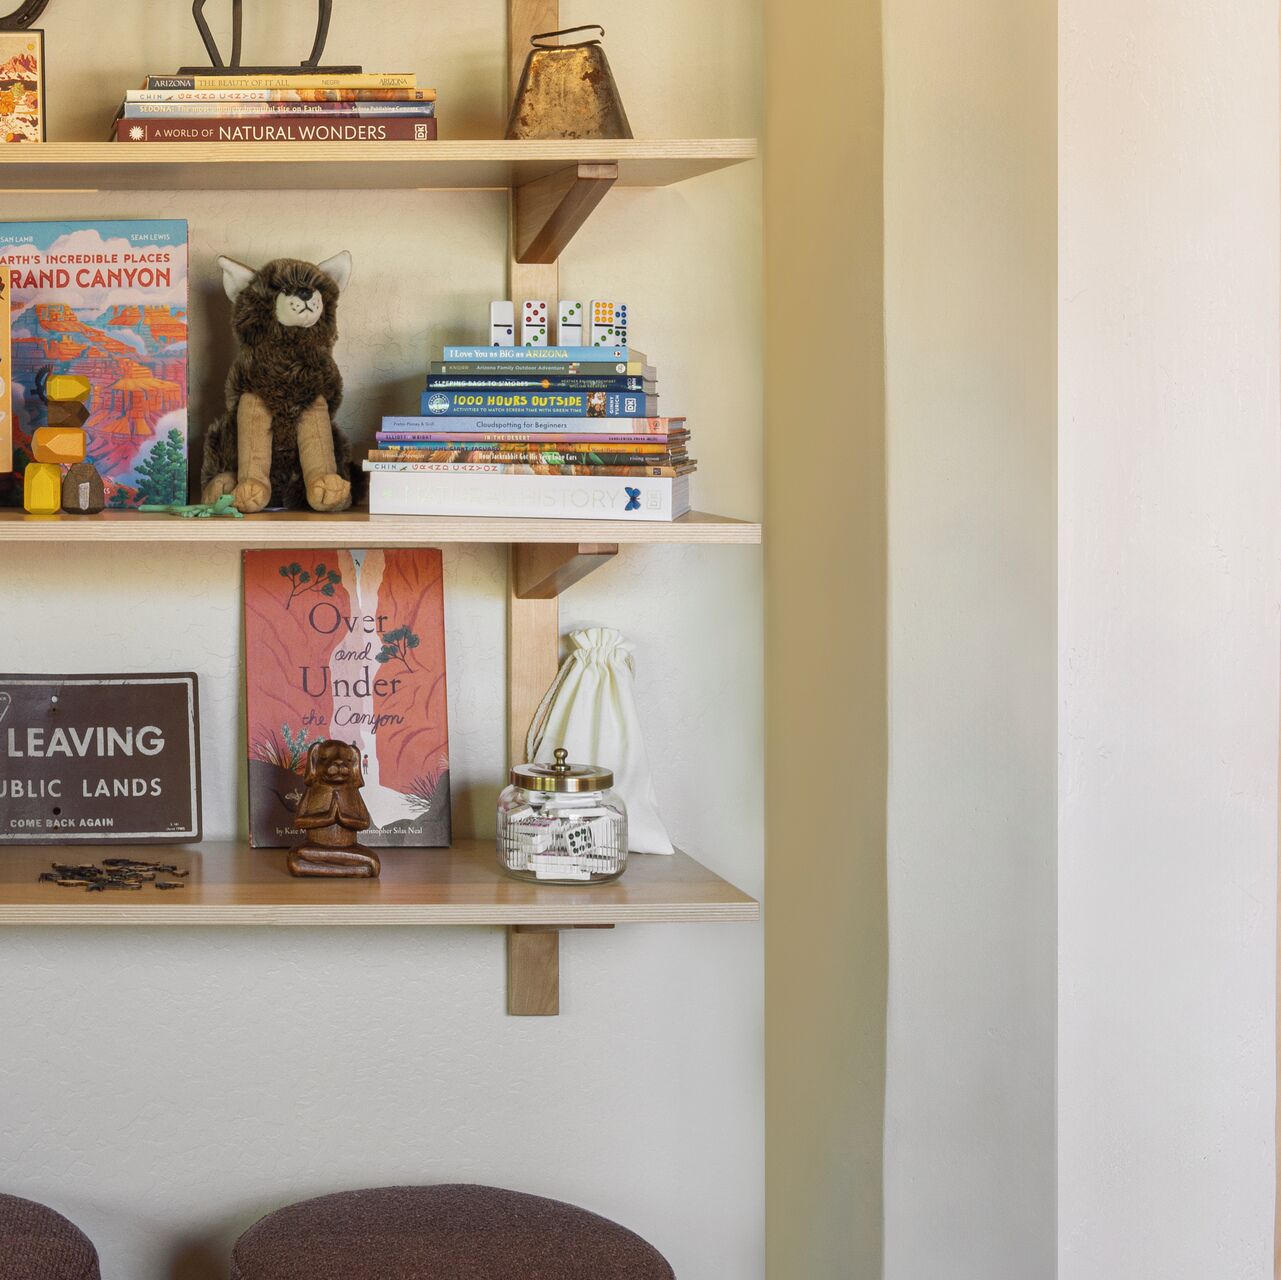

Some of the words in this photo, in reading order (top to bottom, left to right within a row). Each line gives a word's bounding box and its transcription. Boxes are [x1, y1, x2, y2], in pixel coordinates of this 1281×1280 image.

[220, 126, 296, 140] NATURAL
[299, 126, 386, 140] WONDERS
[46, 254, 118, 264] INCREDIBLE
[124, 253, 170, 263] PLACES
[10, 269, 70, 289] RAND
[76, 268, 170, 288] CANYON
[526, 350, 568, 358] ARIZONA
[453, 395, 483, 406] 1000
[487, 396, 527, 406] HOURS
[532, 396, 582, 406] OUTSIDE
[535, 421, 567, 429] Beginners
[309, 602, 388, 634] Over
[335, 642, 372, 660] and
[299, 666, 401, 698] Under
[302, 709, 328, 726] the
[334, 705, 404, 734] Canyon
[8, 726, 165, 757] LEAVING
[83, 778, 162, 797] LANDS
[10, 820, 42, 828] COME
[46, 819, 75, 827] BACK
[79, 818, 114, 827] AGAIN
[276, 828, 283, 836] by
[359, 828, 391, 836] hristopher
